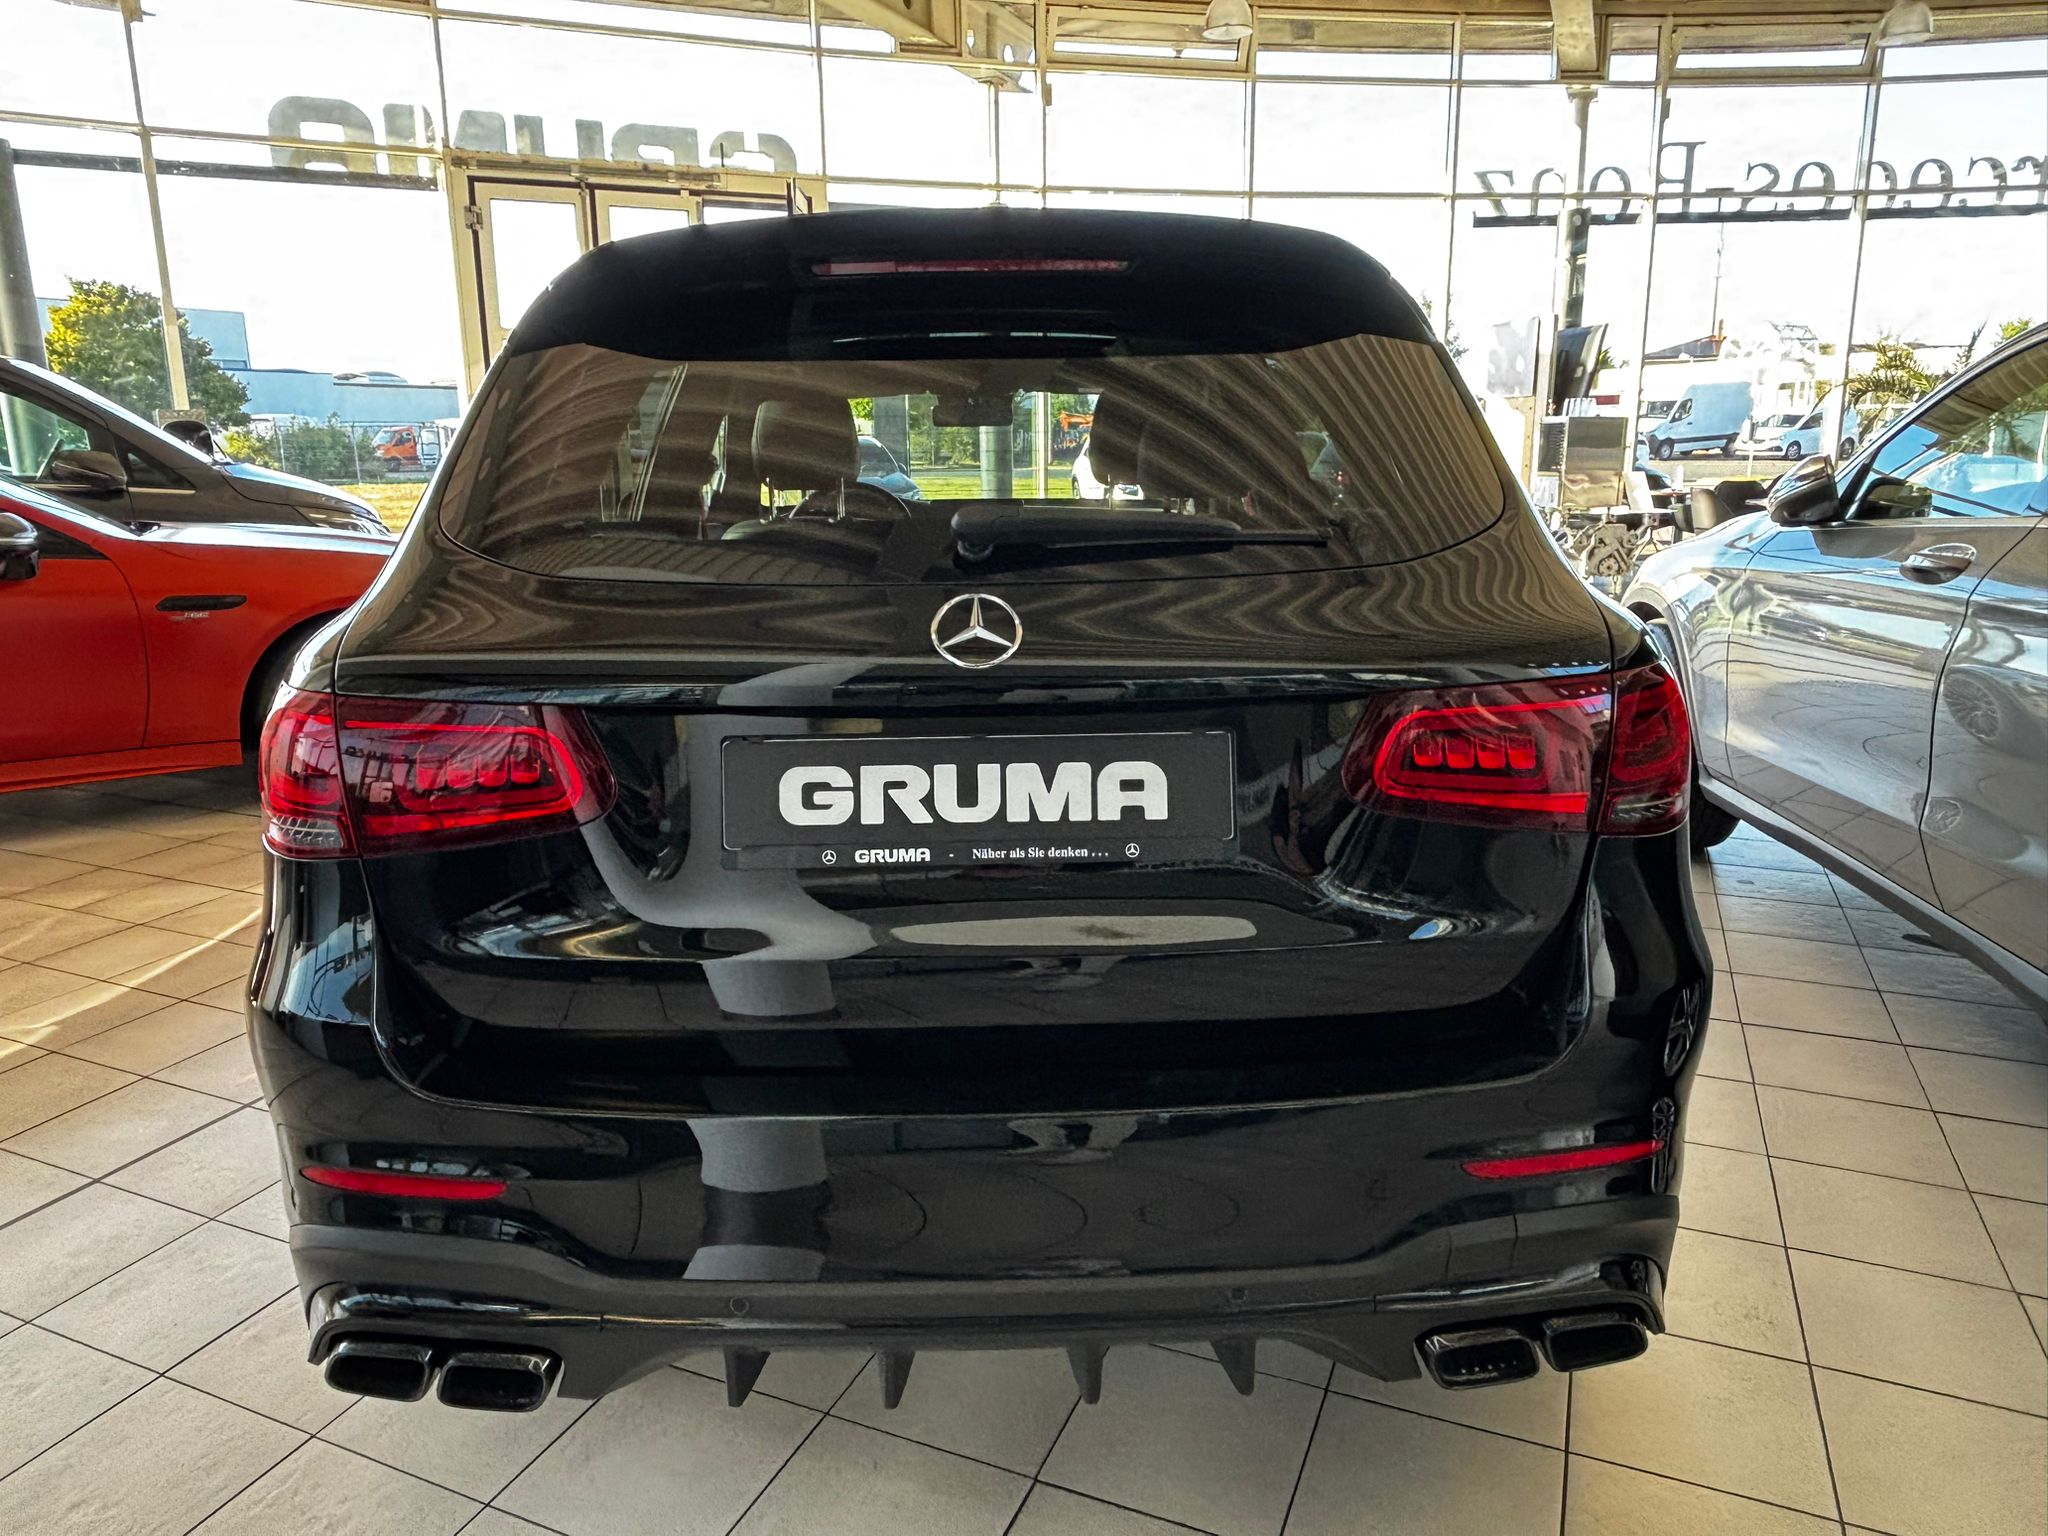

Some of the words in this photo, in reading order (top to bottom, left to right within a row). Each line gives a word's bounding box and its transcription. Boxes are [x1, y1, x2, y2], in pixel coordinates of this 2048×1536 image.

[778, 761, 1168, 826] GRUMA
[854, 848, 931, 863] GRUMA
[972, 848, 1007, 859] Näher
[1009, 847, 1026, 858] als
[1027, 847, 1045, 858] Sie
[1047, 846, 1088, 857] denken
